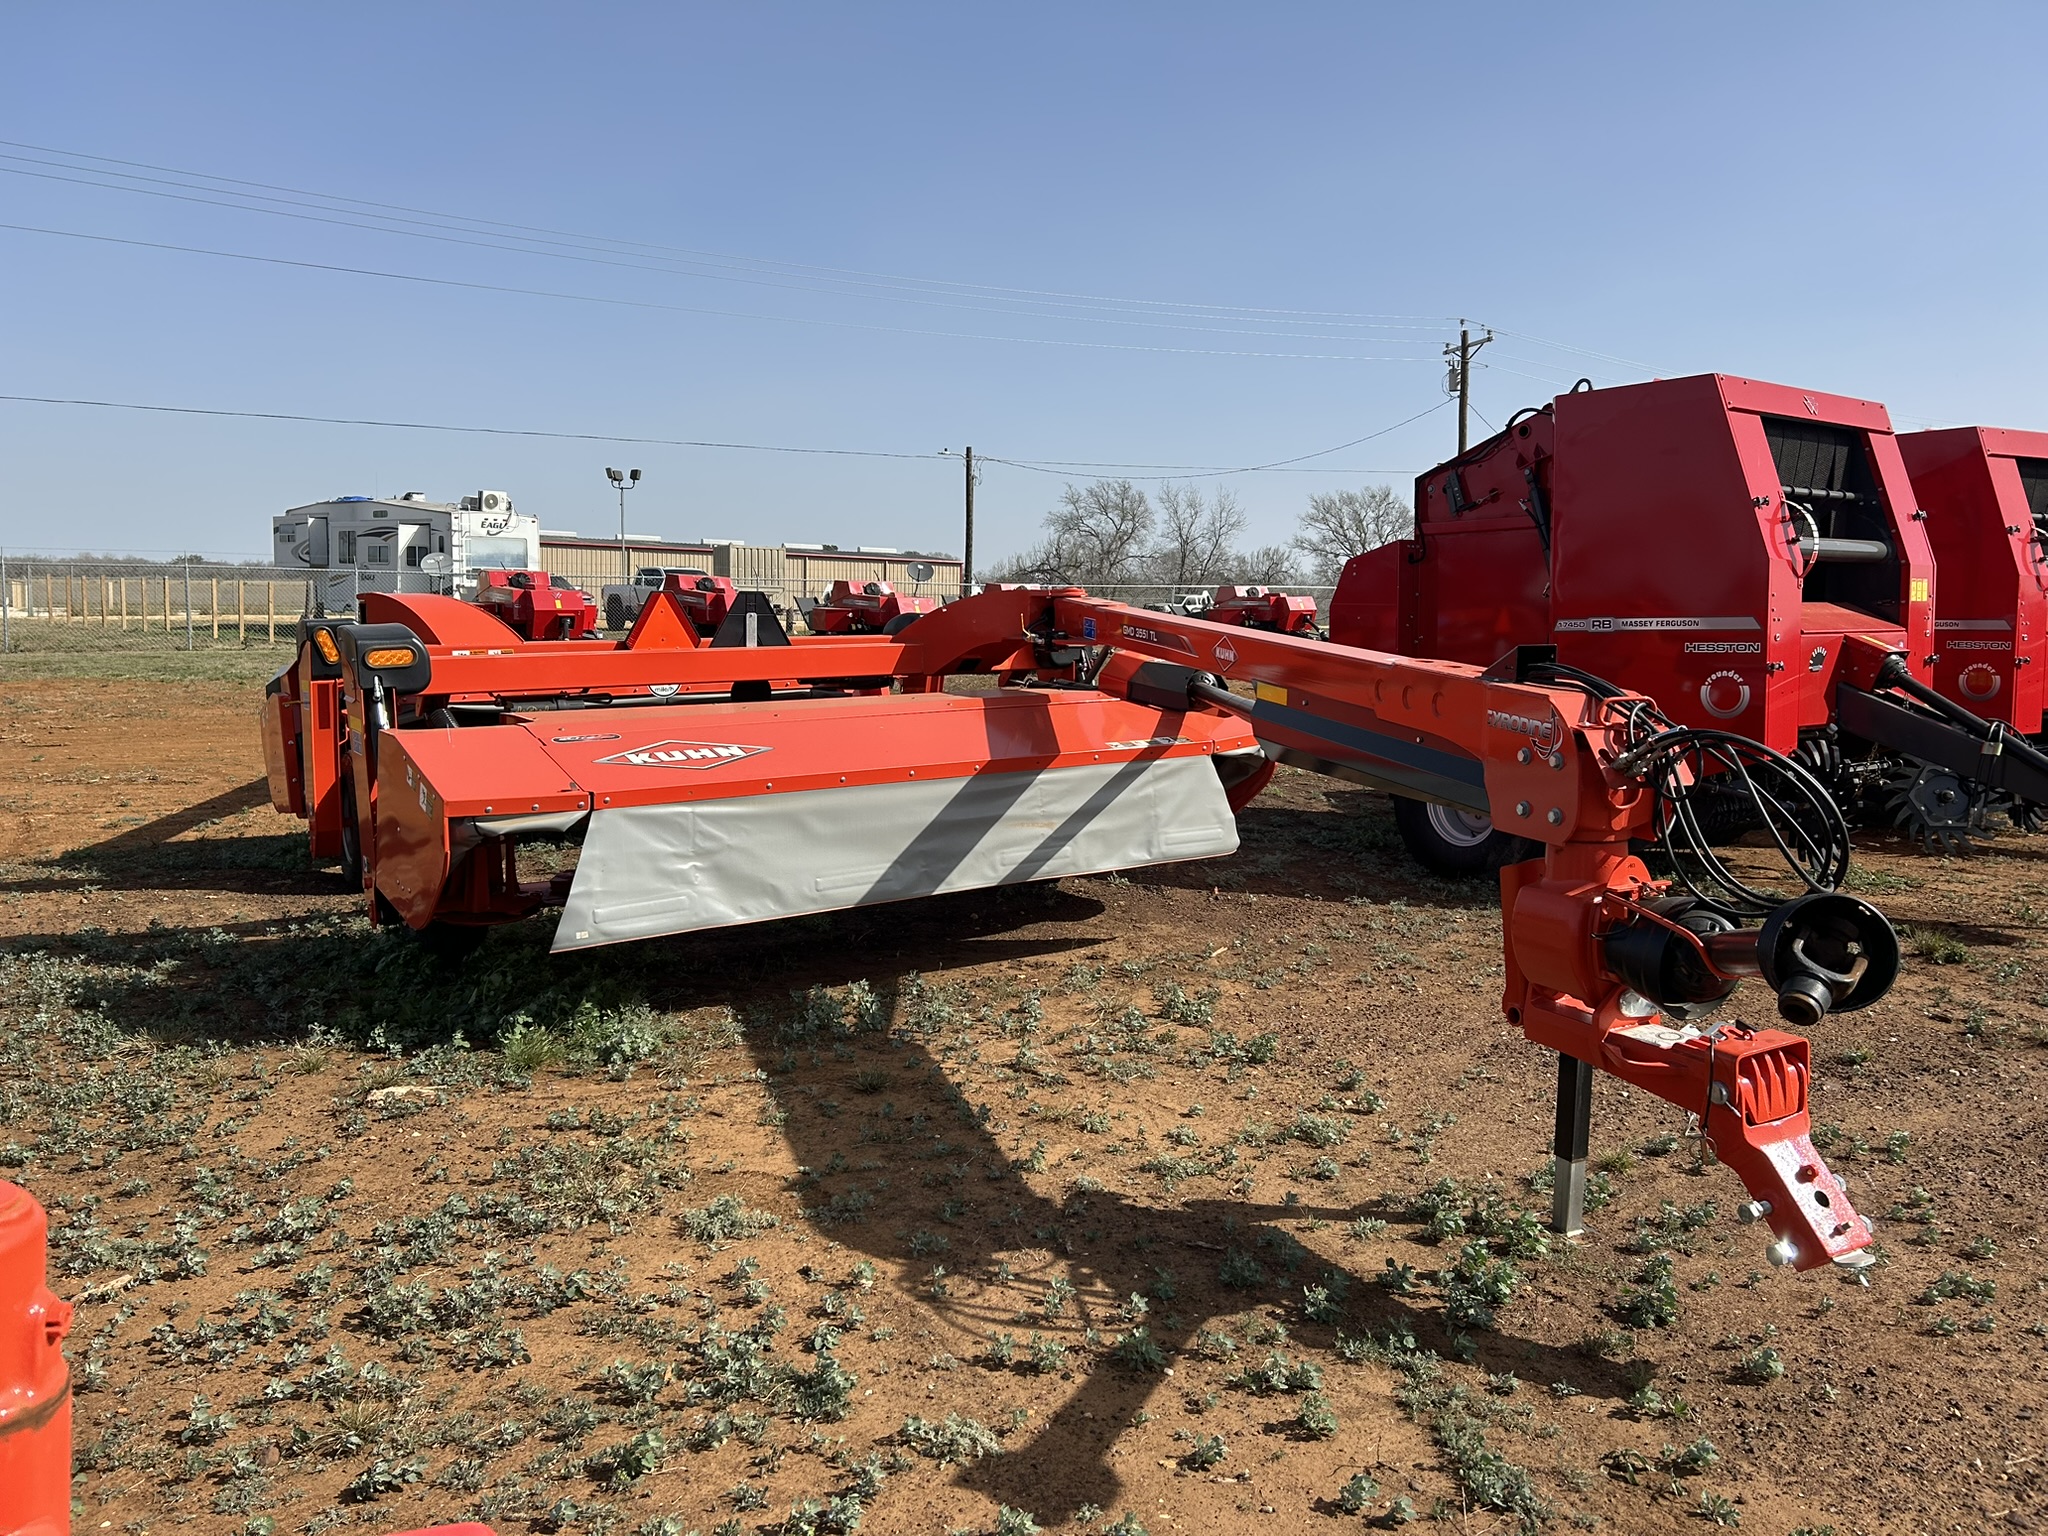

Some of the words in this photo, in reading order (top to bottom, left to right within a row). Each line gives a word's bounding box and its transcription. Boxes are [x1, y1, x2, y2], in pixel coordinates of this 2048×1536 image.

[481, 521, 508, 529] EAGL
[1591, 619, 1613, 630] RB
[1621, 620, 1653, 628] MASSEY
[1122, 625, 1135, 636] GMD
[1135, 628, 1149, 640] 3551
[1149, 631, 1158, 641] TL
[1684, 642, 1761, 653] HESSTON
[1946, 641, 2012, 650] HESSTON
[1215, 646, 1235, 662] KUHN
[1706, 670, 1744, 683] rounder
[624, 746, 748, 765] KUHN
